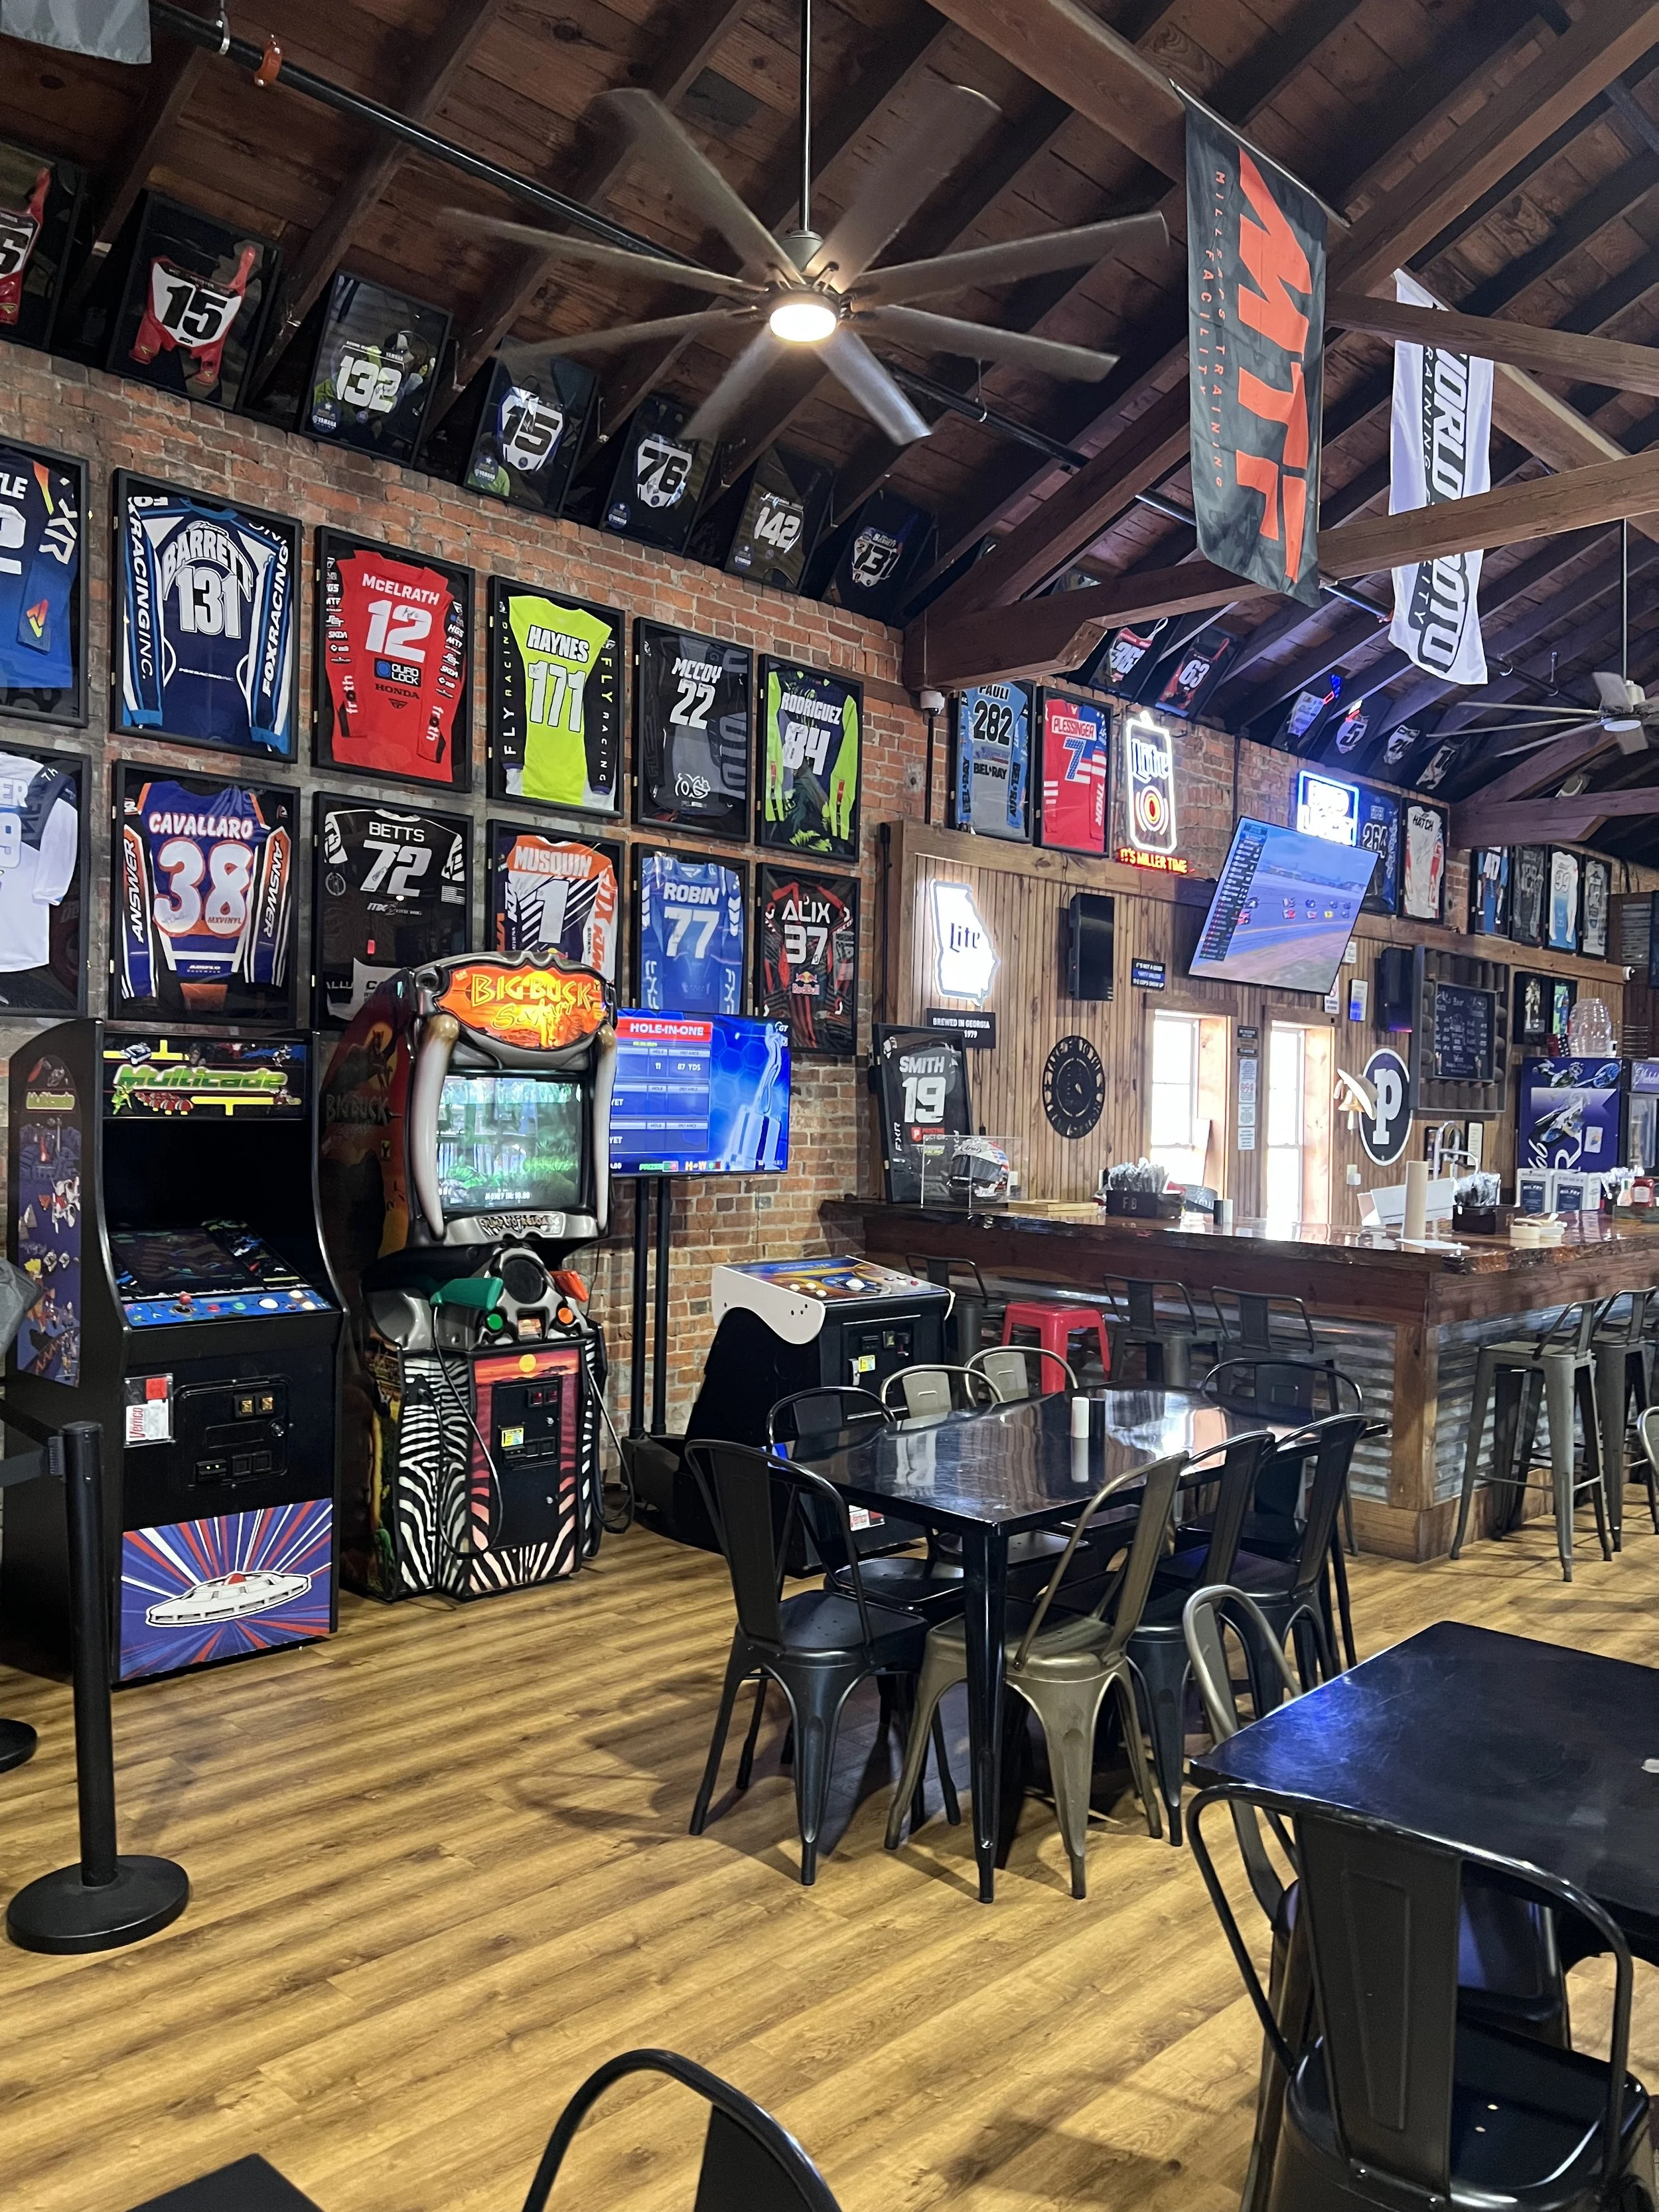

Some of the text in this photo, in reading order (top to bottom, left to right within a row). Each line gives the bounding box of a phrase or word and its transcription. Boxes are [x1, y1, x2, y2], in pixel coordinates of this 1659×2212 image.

[162, 285, 228, 340] 15
[336, 355, 402, 413] 132
[1425, 346, 1433, 470] RAINING
[503, 404, 560, 456] 15
[637, 446, 688, 494] 76
[754, 506, 801, 549] 142
[162, 529, 253, 602] BARRETT
[176, 564, 242, 639] 131
[365, 599, 433, 664] 12
[526, 625, 589, 663] HAYNES
[342, 675, 359, 715] froth
[375, 683, 420, 700] HONDA
[391, 672, 419, 686] LOCK
[502, 622, 516, 755] FLY RACING
[977, 684, 1009, 700] PAULI
[1179, 659, 1210, 688] 63
[528, 660, 587, 733] 171
[670, 678, 716, 730] 22
[781, 692, 843, 725] RODRIGUEZ
[426, 705, 444, 741] froth
[599, 657, 613, 782] FLY RACING
[973, 700, 1013, 747] 282
[1053, 717, 1095, 737] PLESSINGER
[782, 721, 831, 776] 84
[1062, 737, 1087, 781] 7
[149, 811, 254, 840] CAVALLARO
[1095, 782, 1105, 827] THOR
[369, 822, 425, 842] BETTS
[360, 840, 432, 897] 72
[514, 846, 593, 877] MUSQUIN
[1119, 848, 1188, 873] IT'S MILLER TIME
[123, 838, 144, 944] ANSWER
[153, 837, 254, 936] 38
[263, 838, 284, 938] ANSWER
[664, 882, 719, 905] ROBIN
[536, 878, 571, 944] 1
[664, 906, 720, 959] 77
[782, 899, 831, 924] ALIX
[784, 924, 828, 966] 37
[950, 922, 980, 953] Lite
[472, 974, 524, 1007] BIG
[630, 1023, 704, 1037] HOLE-IN-ONE
[933, 1017, 991, 1029] BREWED IN GEORGIA
[964, 1030, 977, 1039] 1979
[113, 1064, 289, 1090] Multicade
[899, 1056, 945, 1074] SMITH
[902, 1076, 946, 1124] 19
